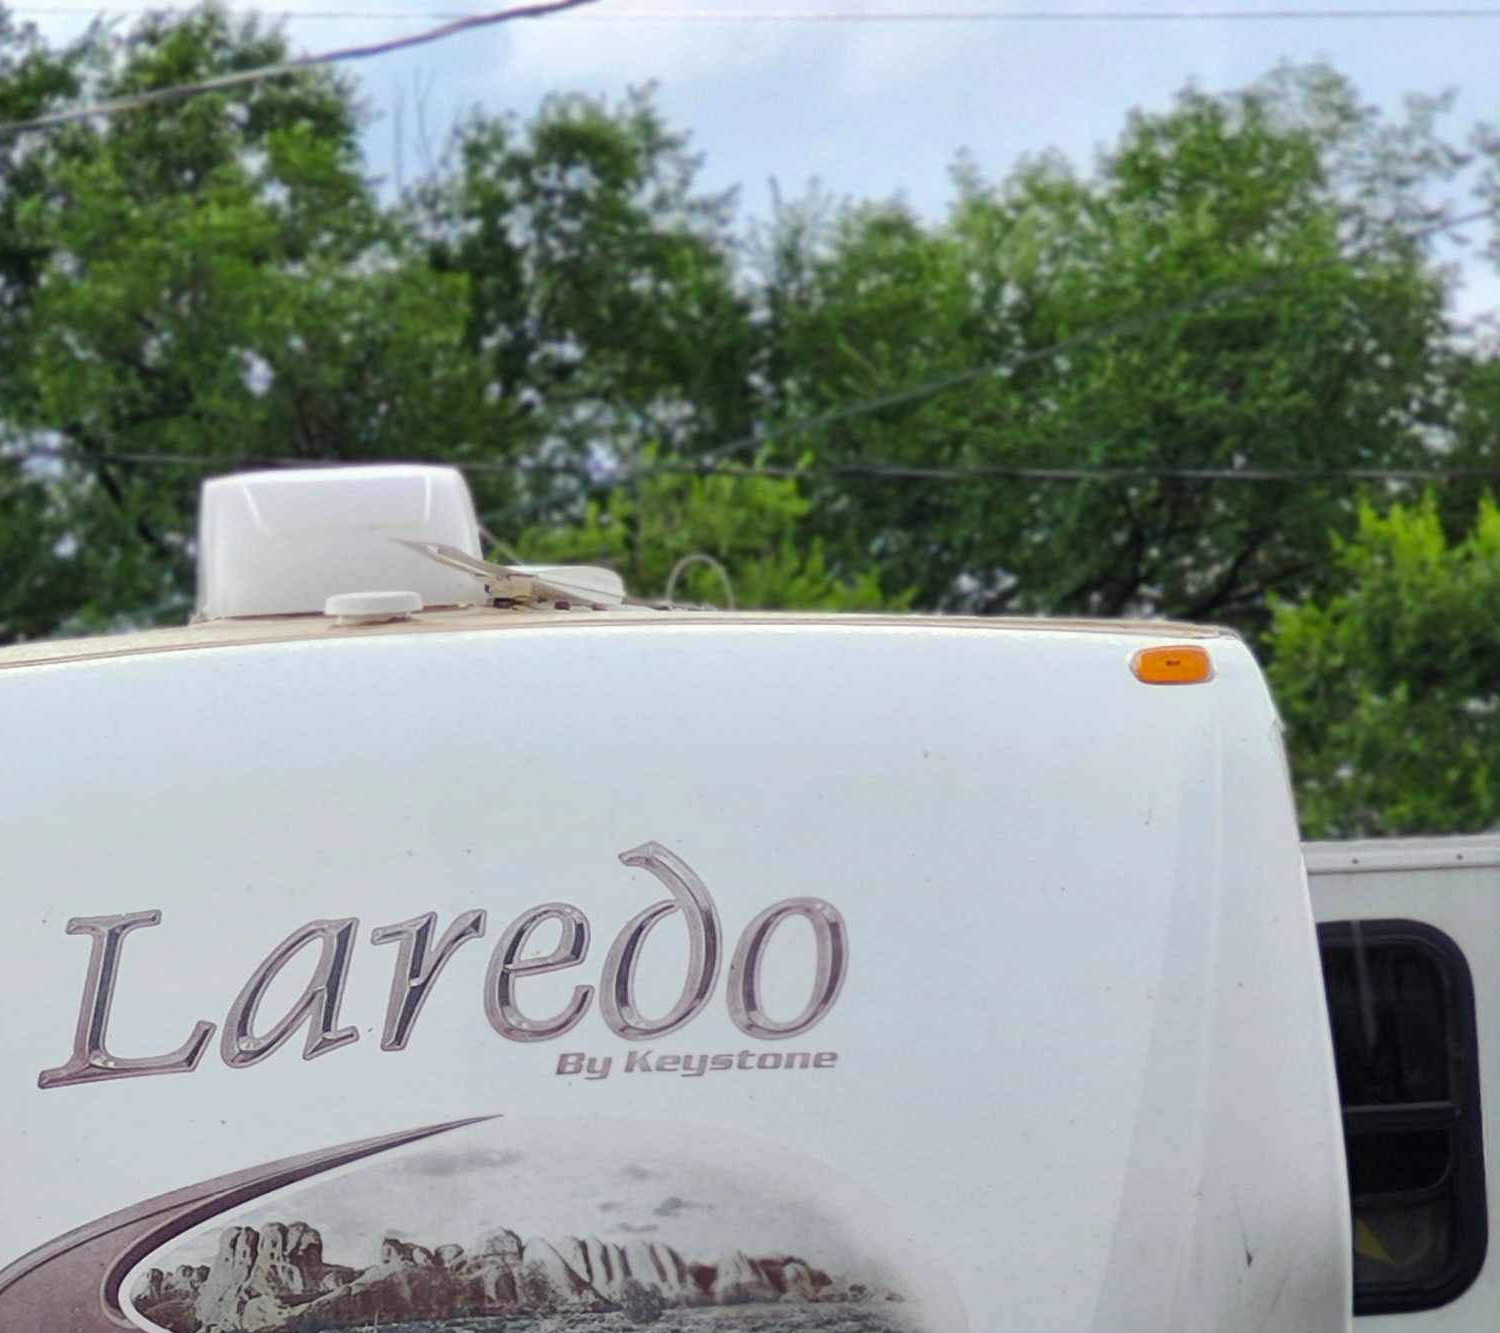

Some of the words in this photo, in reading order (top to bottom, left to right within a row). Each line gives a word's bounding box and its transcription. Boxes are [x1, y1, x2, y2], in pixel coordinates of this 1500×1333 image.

[37, 840, 850, 1089] Laredo
[555, 1052, 613, 1080] By
[623, 1050, 839, 1078] Keystone
